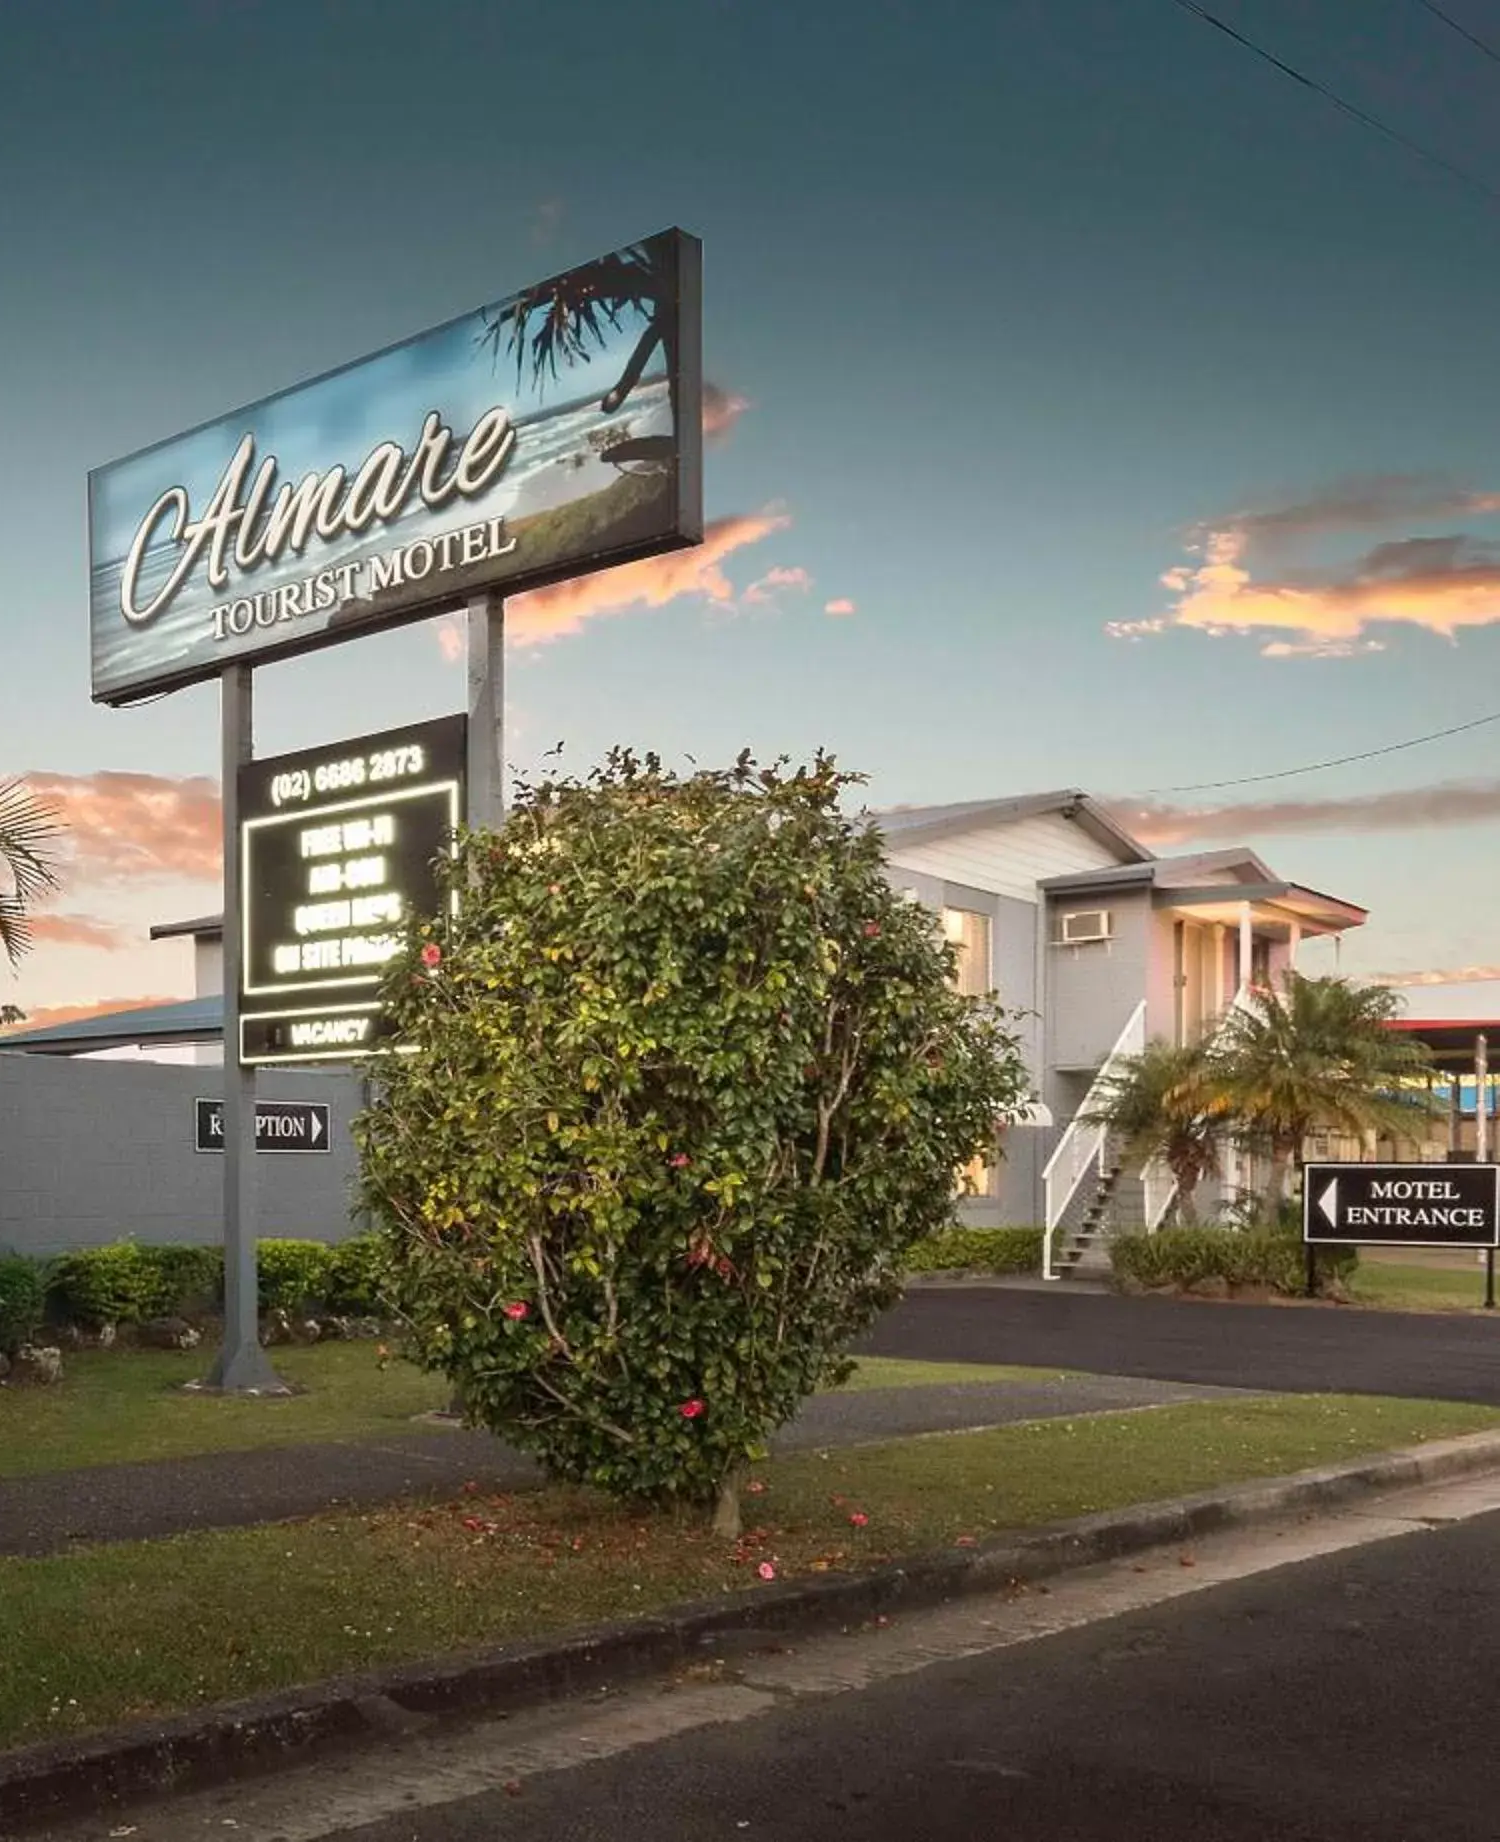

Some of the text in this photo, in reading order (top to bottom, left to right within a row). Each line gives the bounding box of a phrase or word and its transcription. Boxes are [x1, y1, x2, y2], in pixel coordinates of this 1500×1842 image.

[117, 404, 518, 625] Almare
[210, 517, 518, 641] TOURIST MOTEL
[271, 770, 311, 806] (02)
[291, 1018, 369, 1046] VACANCY
[209, 1114, 306, 1137] RPTION
[1370, 1180, 1461, 1200] MOTEL
[1346, 1206, 1485, 1227] ENTRANCE
